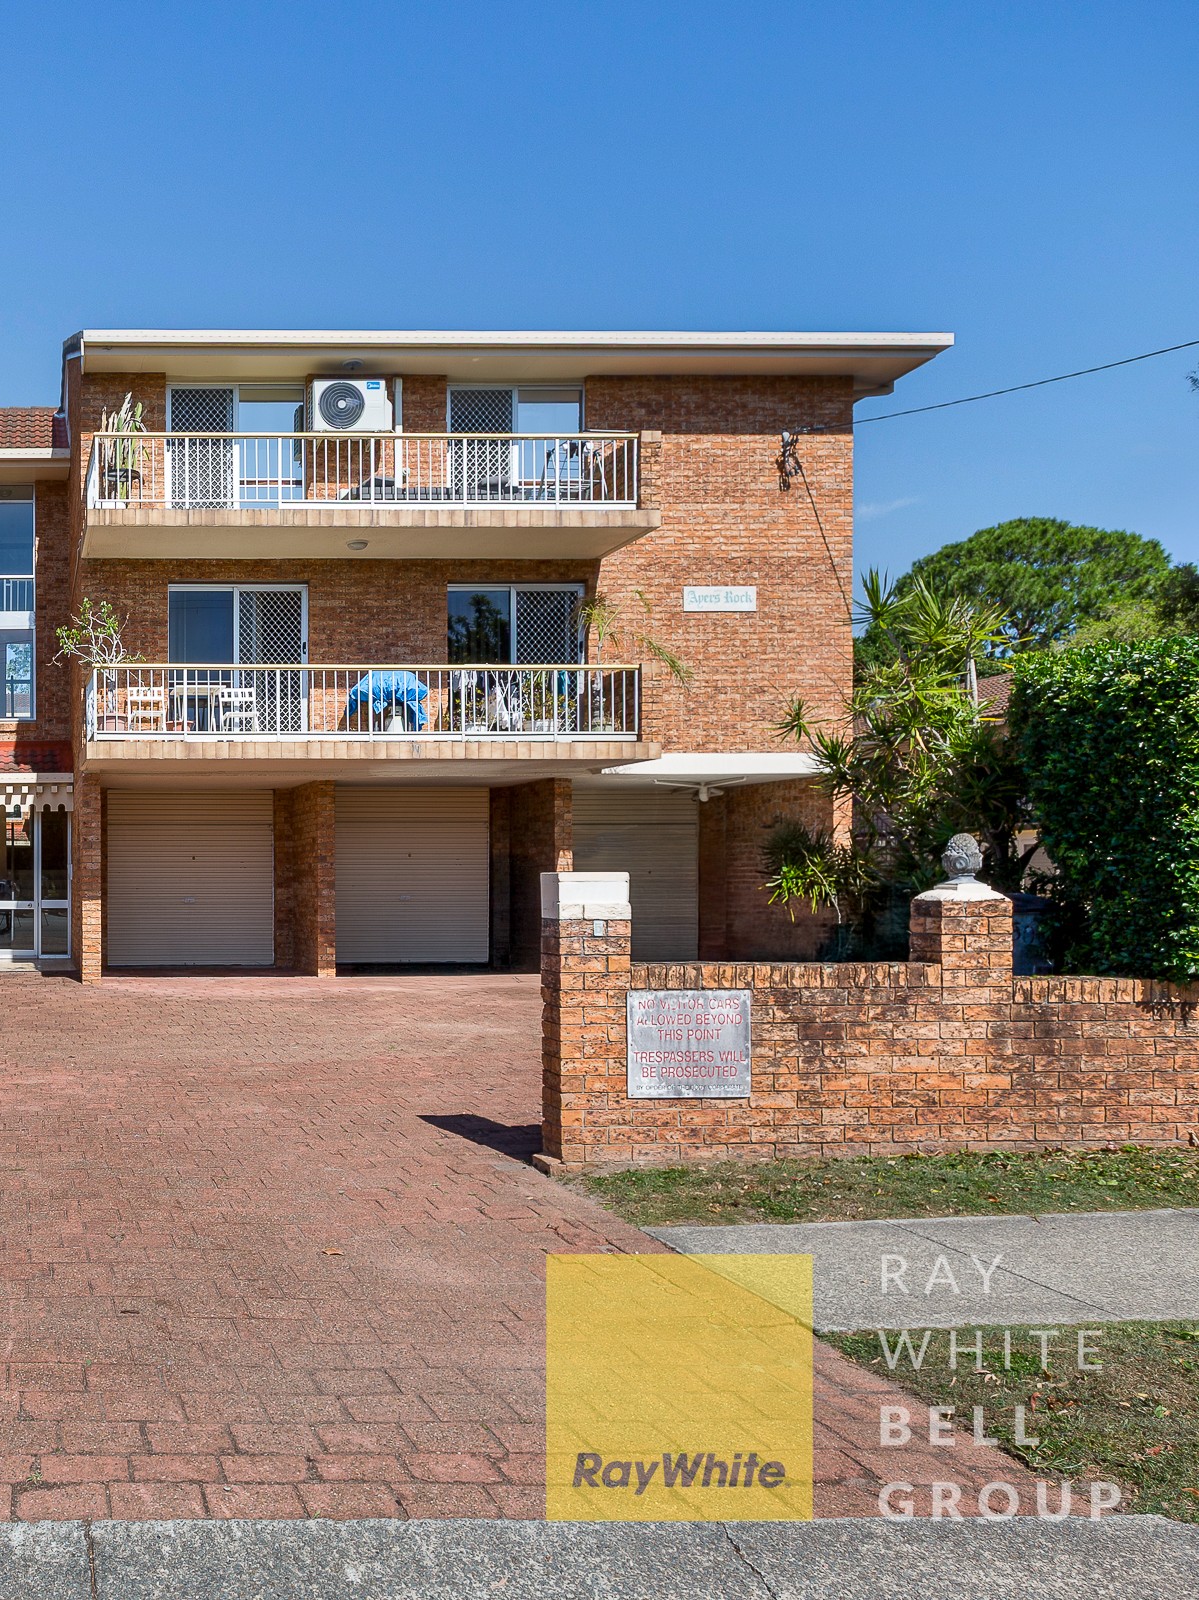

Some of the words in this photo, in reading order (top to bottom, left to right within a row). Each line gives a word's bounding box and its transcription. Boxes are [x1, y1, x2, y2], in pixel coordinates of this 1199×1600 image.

[688, 590, 720, 608] Ayers
[724, 591, 753, 603] Rock
[638, 999, 656, 1011] NO
[709, 998, 740, 1010] CARS
[695, 1013, 743, 1026] BEYOND
[657, 1028, 683, 1041] THIS
[687, 1028, 722, 1041] POINT
[634, 1050, 714, 1063] TRESPASSERS
[718, 1050, 746, 1063] WILL
[641, 1066, 657, 1078] BE
[661, 1065, 738, 1078] PROSECUTED
